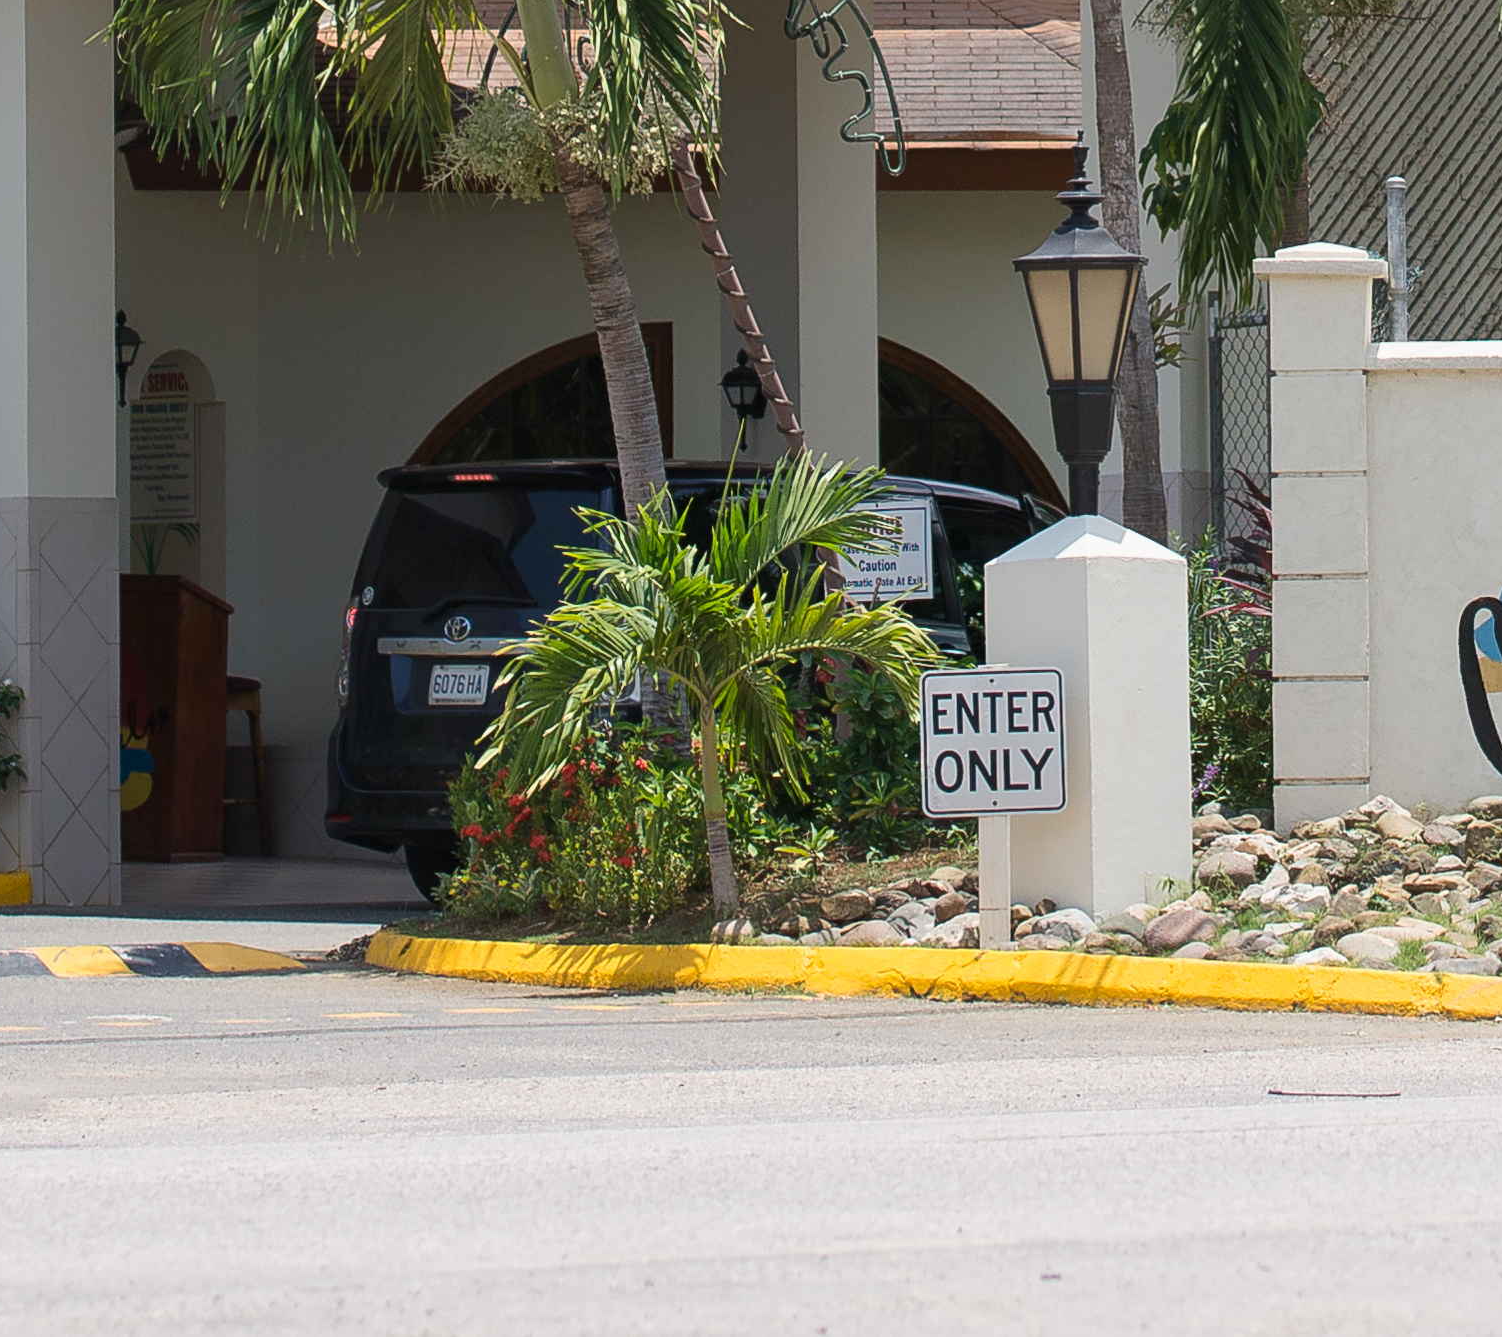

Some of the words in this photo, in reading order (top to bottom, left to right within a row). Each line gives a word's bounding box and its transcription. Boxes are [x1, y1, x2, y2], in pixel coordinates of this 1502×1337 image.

[148, 372, 190, 393] SERVIC
[901, 542, 920, 552] With
[859, 559, 897, 572] Caution
[843, 577, 873, 587] tomatic
[896, 576, 905, 586] At
[907, 575, 923, 586] Exit
[932, 691, 1055, 736] ENTER
[934, 748, 1055, 794] ONLY
